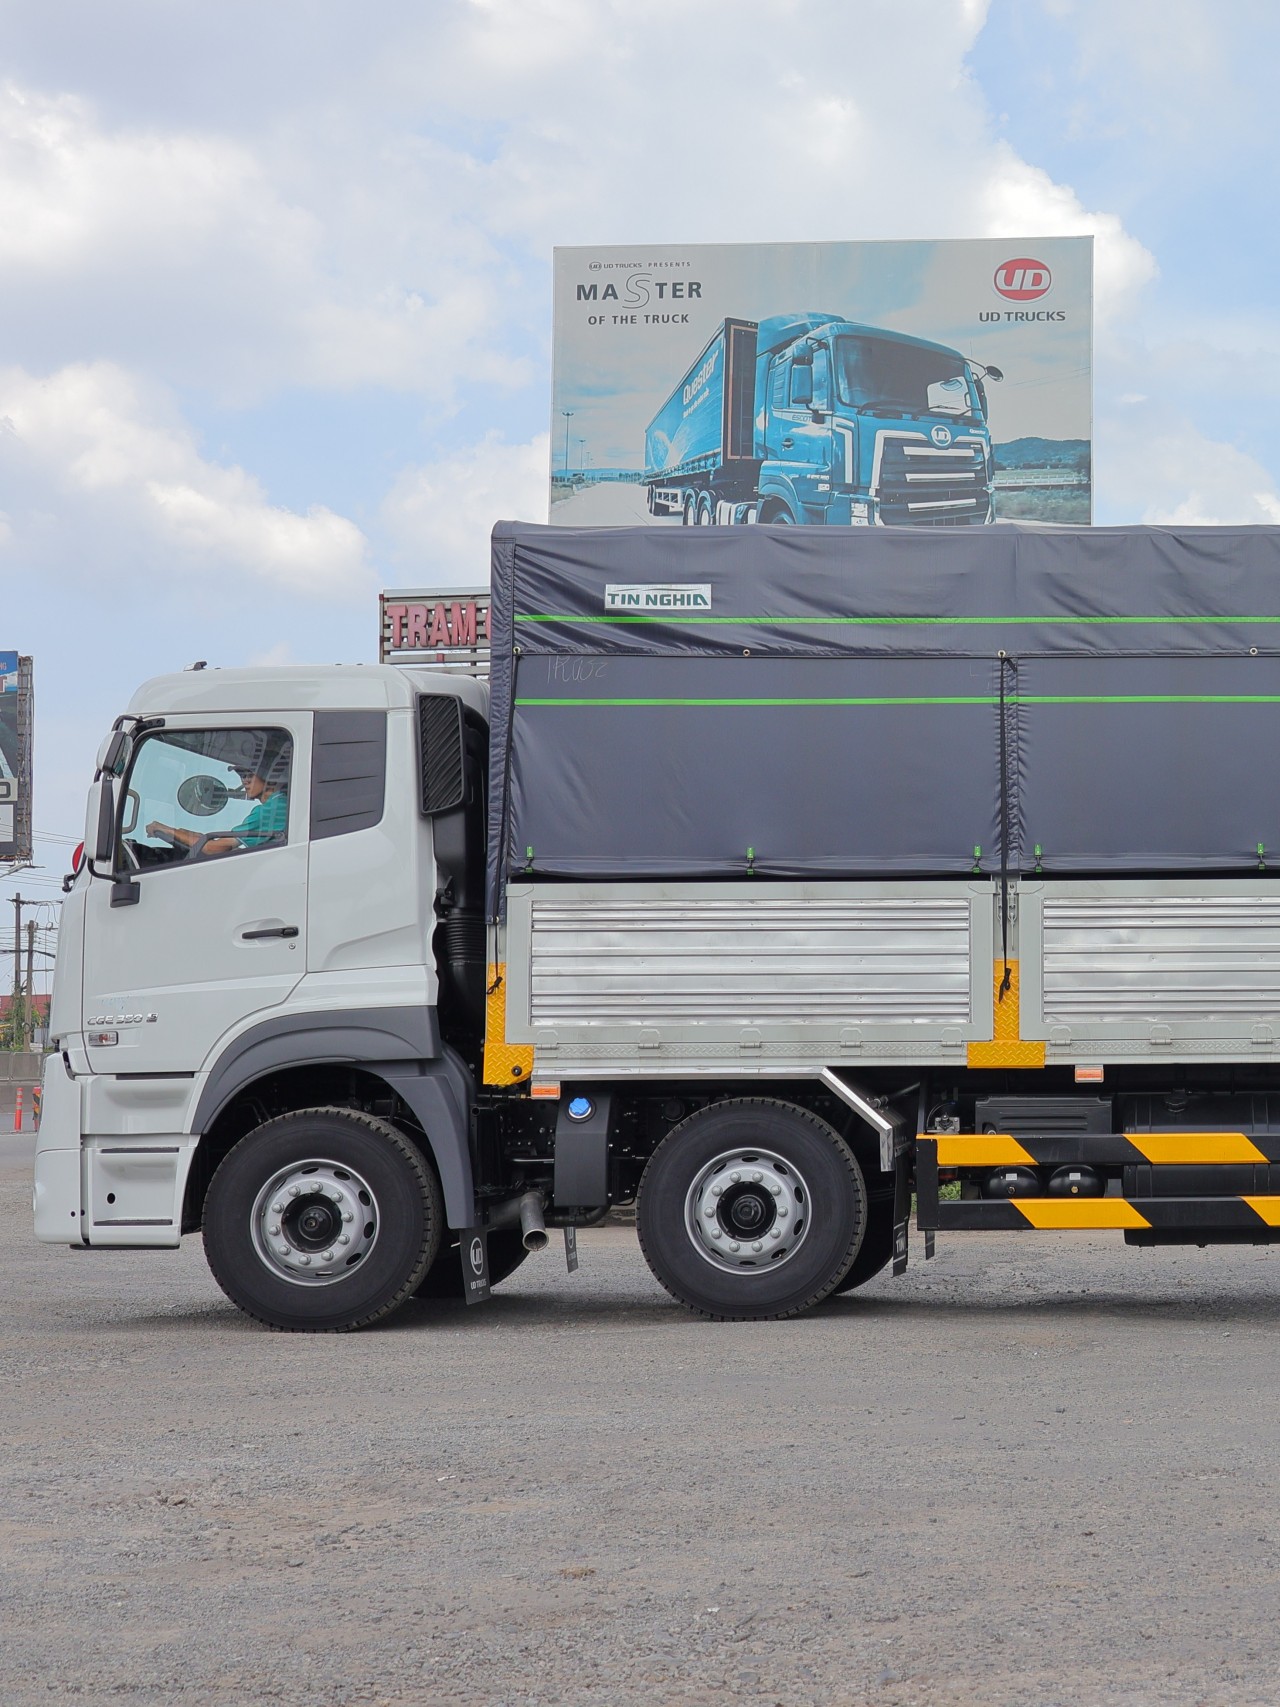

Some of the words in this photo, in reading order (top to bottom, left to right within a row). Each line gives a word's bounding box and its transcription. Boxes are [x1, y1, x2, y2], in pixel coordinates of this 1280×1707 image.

[996, 269, 1050, 290] UD
[576, 272, 702, 309] MASTER
[588, 316, 605, 325] OF
[612, 315, 637, 324] THE
[644, 314, 689, 324] TRUCK
[979, 312, 1001, 322] UD
[1004, 311, 1066, 321] TRUCKS
[683, 350, 719, 405] Quester
[607, 593, 640, 605] TIN
[645, 593, 709, 606] NGHIA
[116, 1013, 143, 1024] 350
